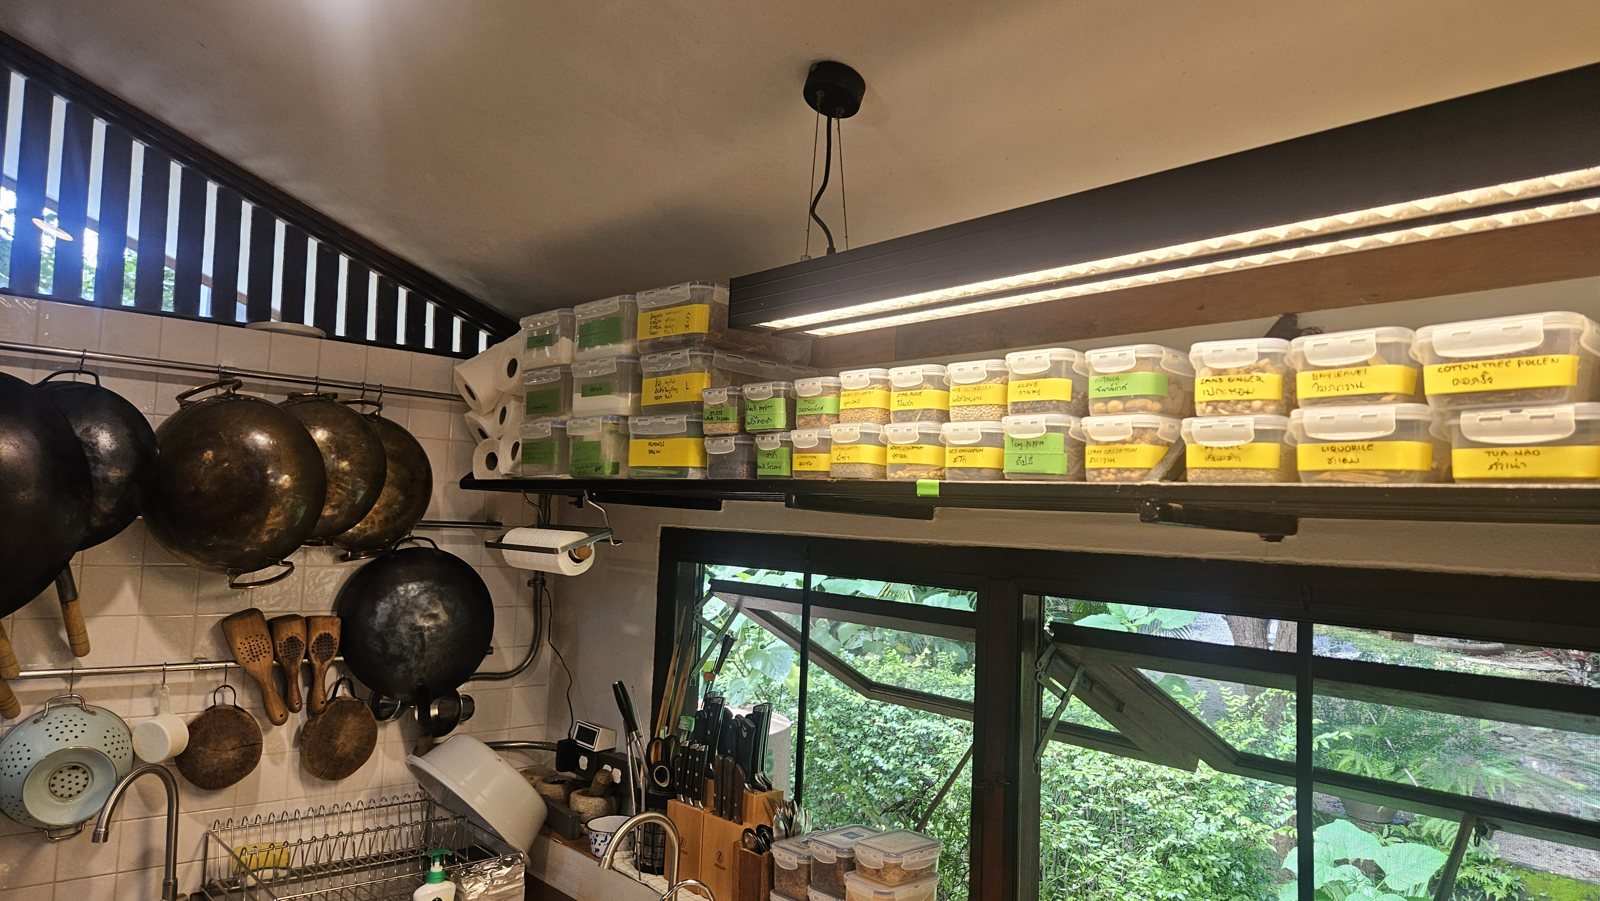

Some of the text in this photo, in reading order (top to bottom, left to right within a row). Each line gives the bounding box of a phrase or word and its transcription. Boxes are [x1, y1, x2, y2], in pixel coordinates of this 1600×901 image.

[1437, 363, 1479, 374] COTTON
[1517, 357, 1560, 369] POLLEN
[1320, 443, 1375, 453] LIQUORICE
[1484, 449, 1541, 457] TUA NAO
